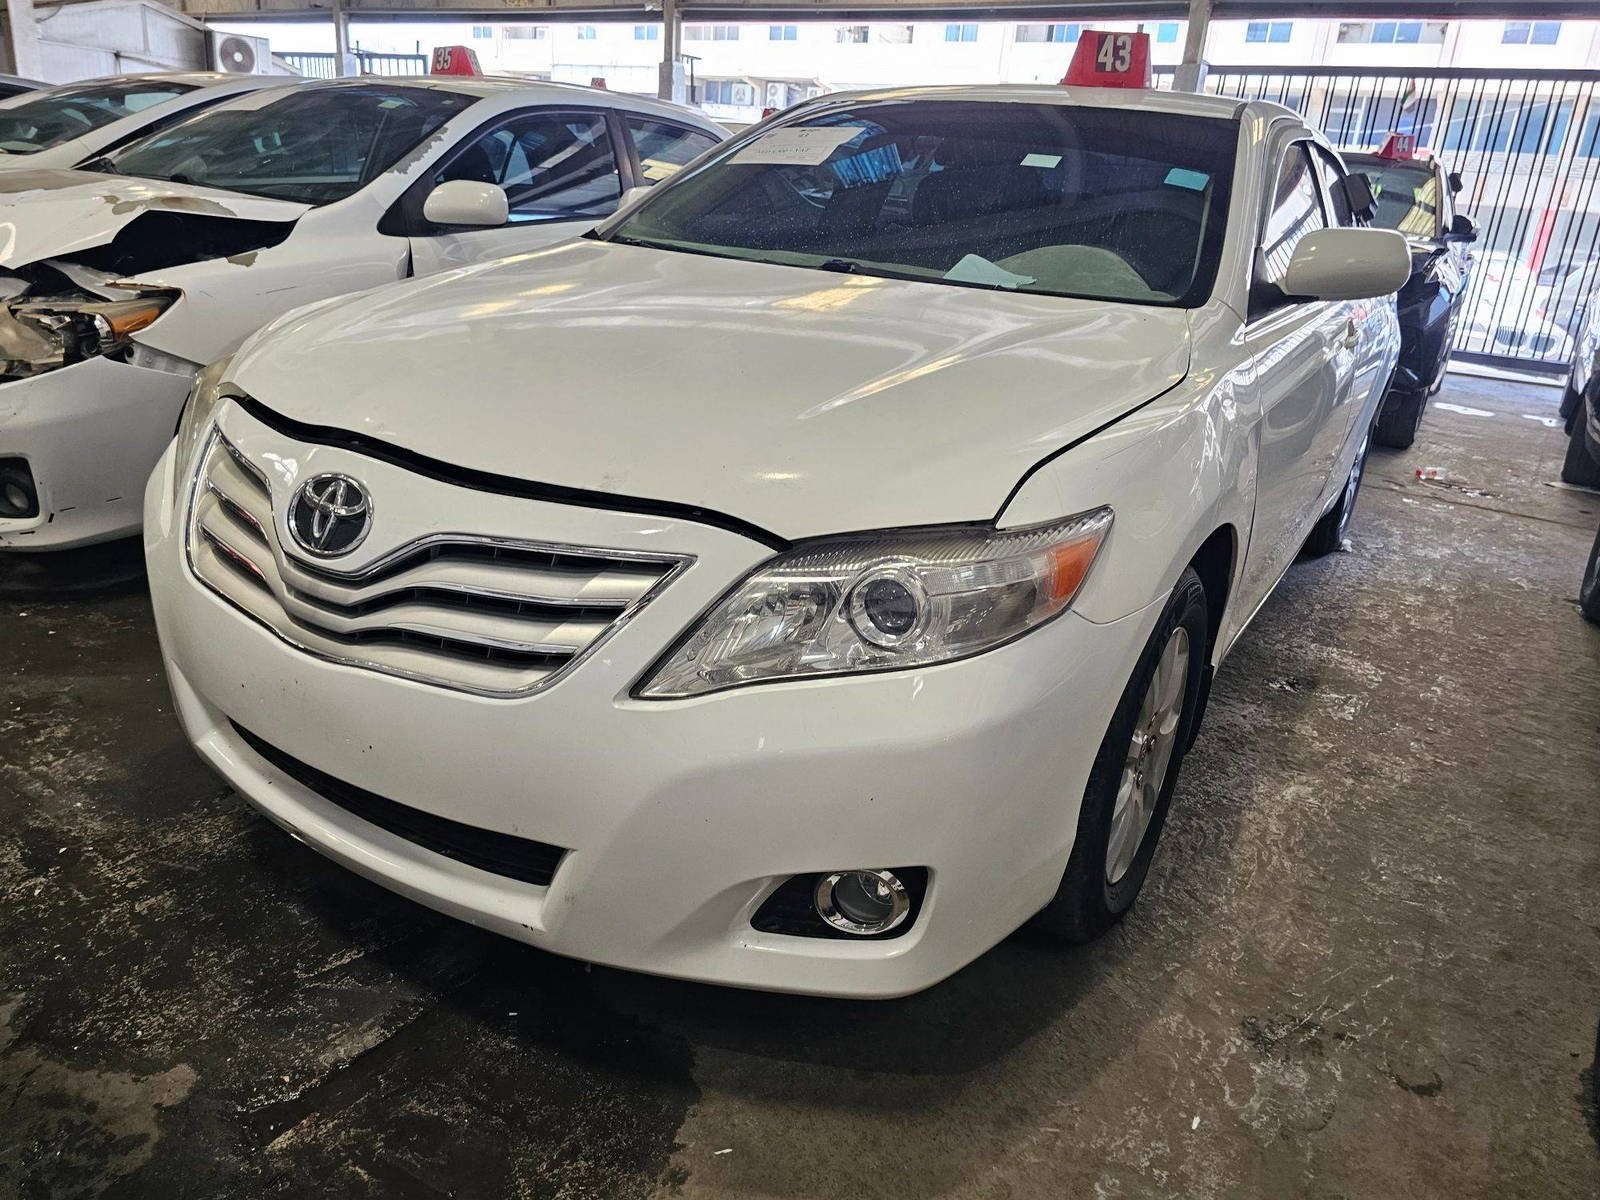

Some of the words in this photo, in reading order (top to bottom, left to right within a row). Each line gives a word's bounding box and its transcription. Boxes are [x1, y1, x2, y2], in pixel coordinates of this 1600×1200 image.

[436, 47, 452, 70] 35
[1098, 34, 1132, 72] 43
[1397, 137, 1409, 152] 44
